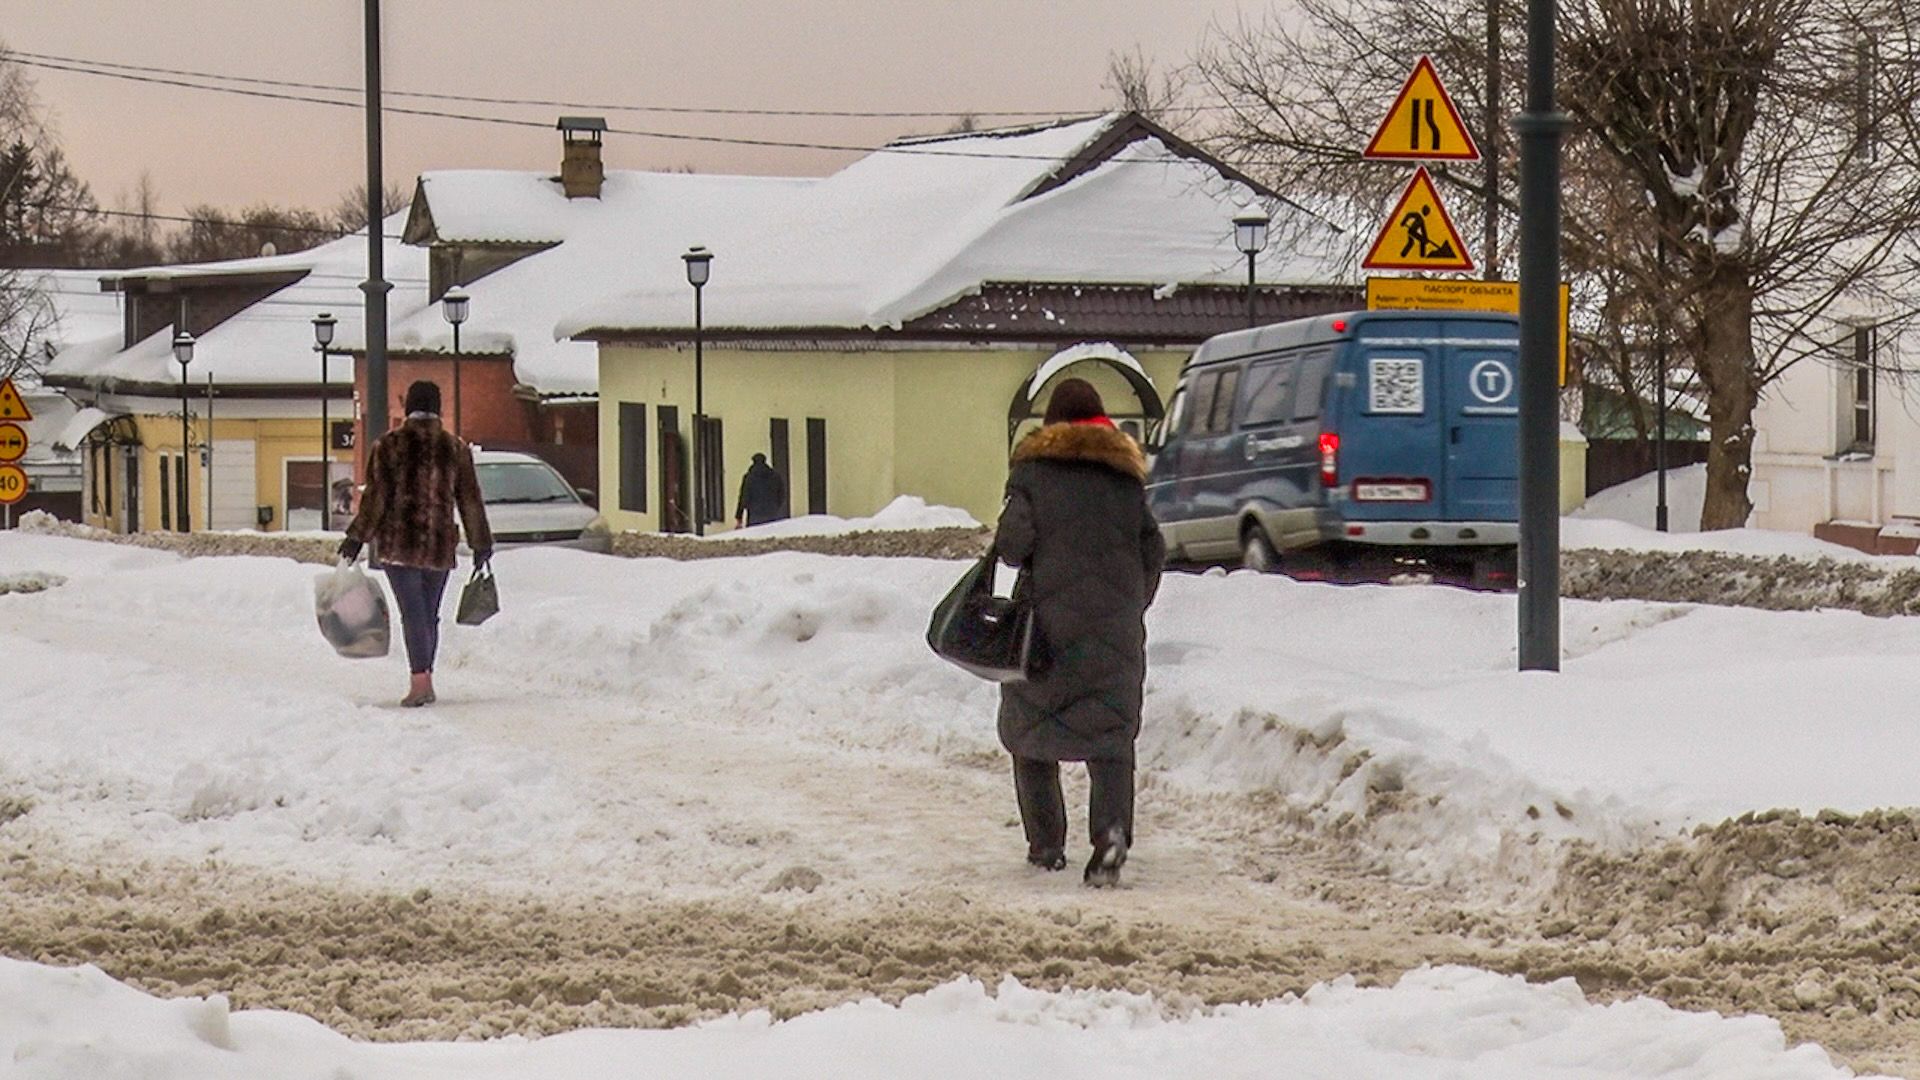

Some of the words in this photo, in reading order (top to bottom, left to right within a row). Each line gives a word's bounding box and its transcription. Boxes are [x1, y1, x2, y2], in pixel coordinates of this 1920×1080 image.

[1424, 285, 1466, 294] ПАСПОРТ
[1469, 286, 1513, 295] ОБЪЕКТА
[0, 475, 18, 491] 40
